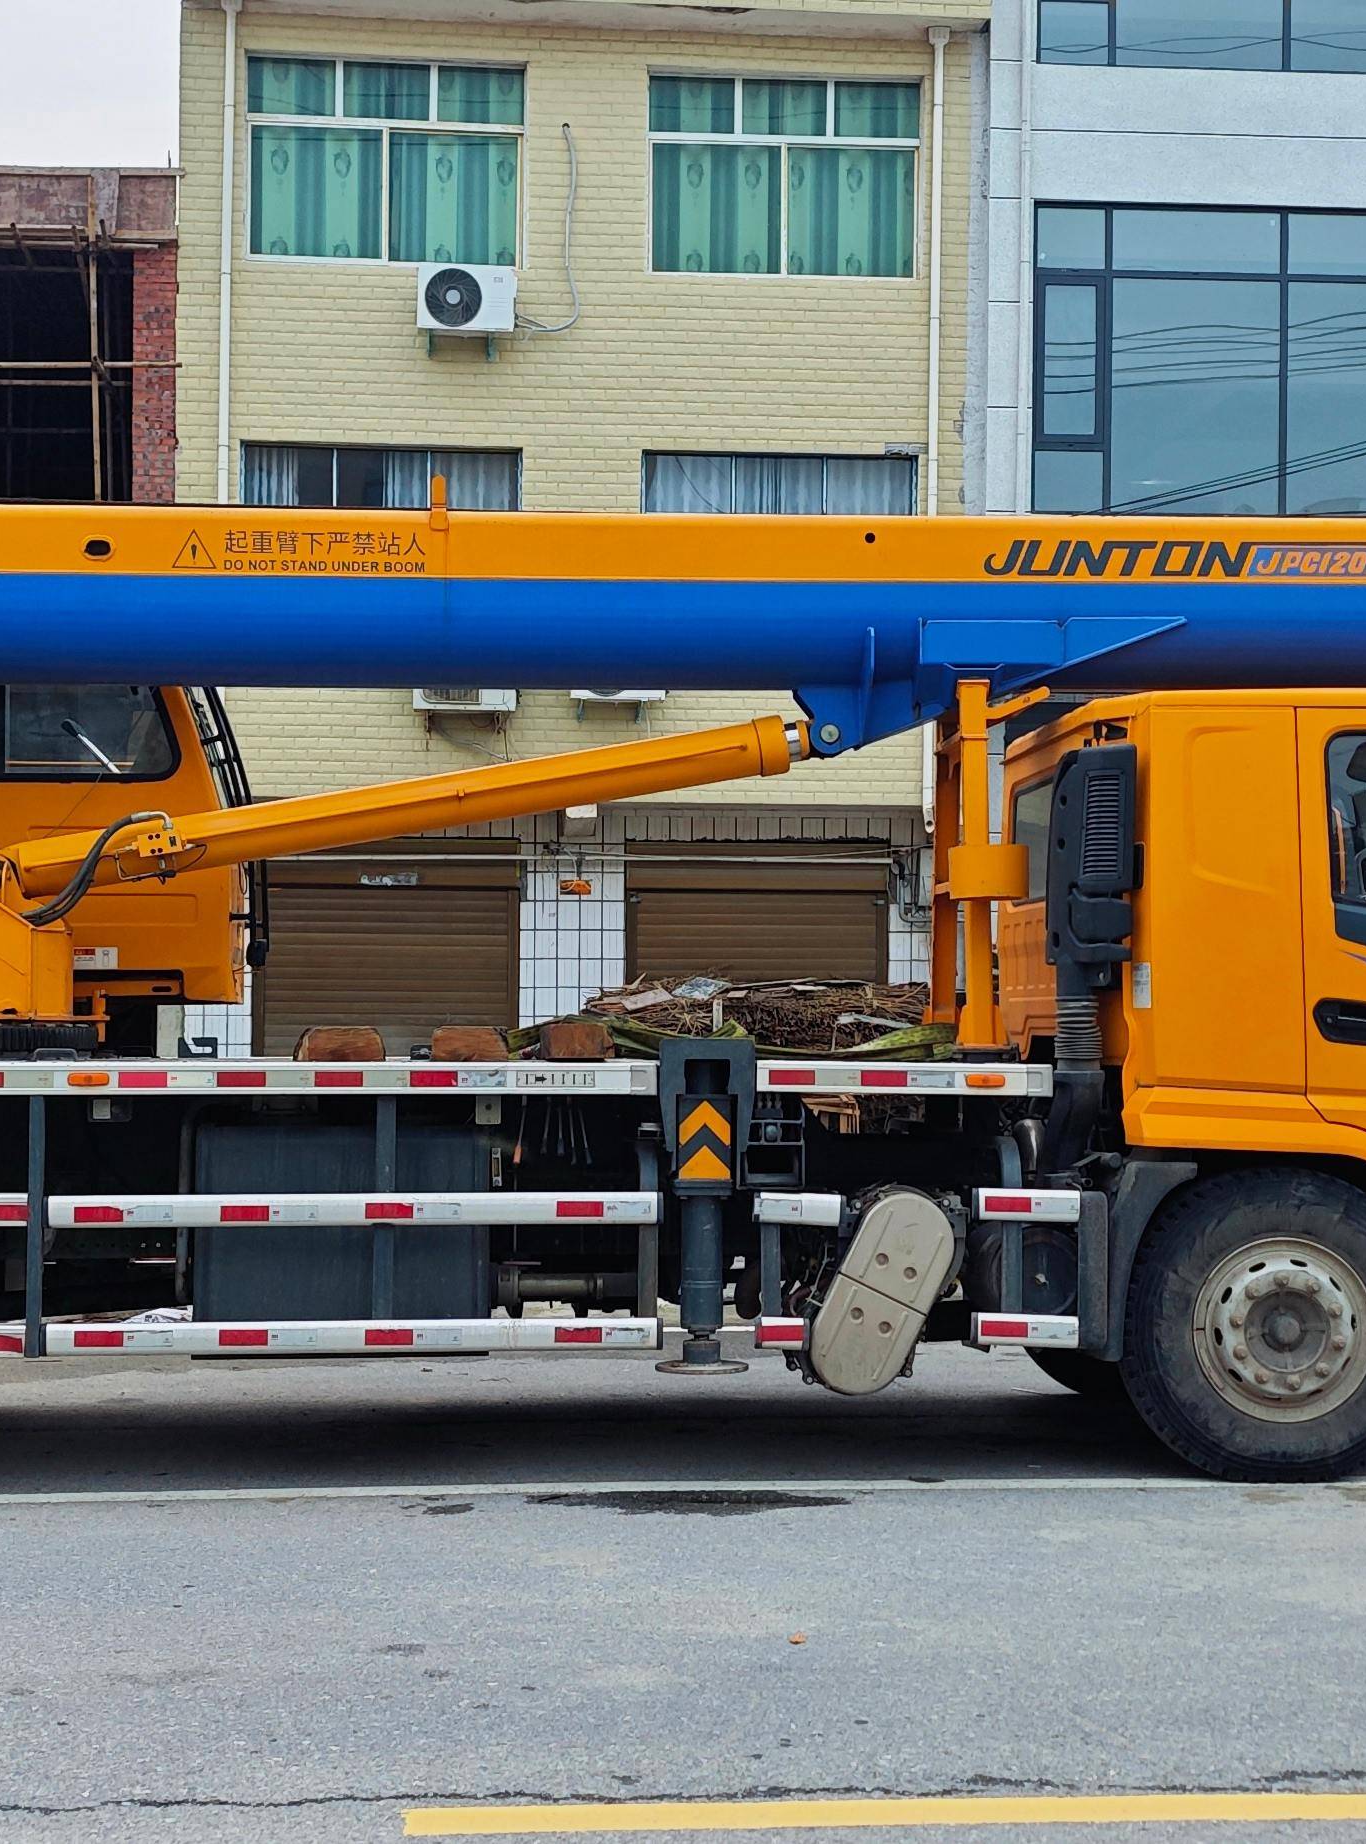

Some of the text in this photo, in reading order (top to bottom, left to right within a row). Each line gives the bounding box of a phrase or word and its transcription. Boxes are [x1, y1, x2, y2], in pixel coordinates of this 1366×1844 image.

[223, 529, 426, 557] 起重臂下严禁站人
[223, 559, 426, 573] DO NOT STAND UNDER BOOM
[983, 539, 1255, 578] JUNTON
